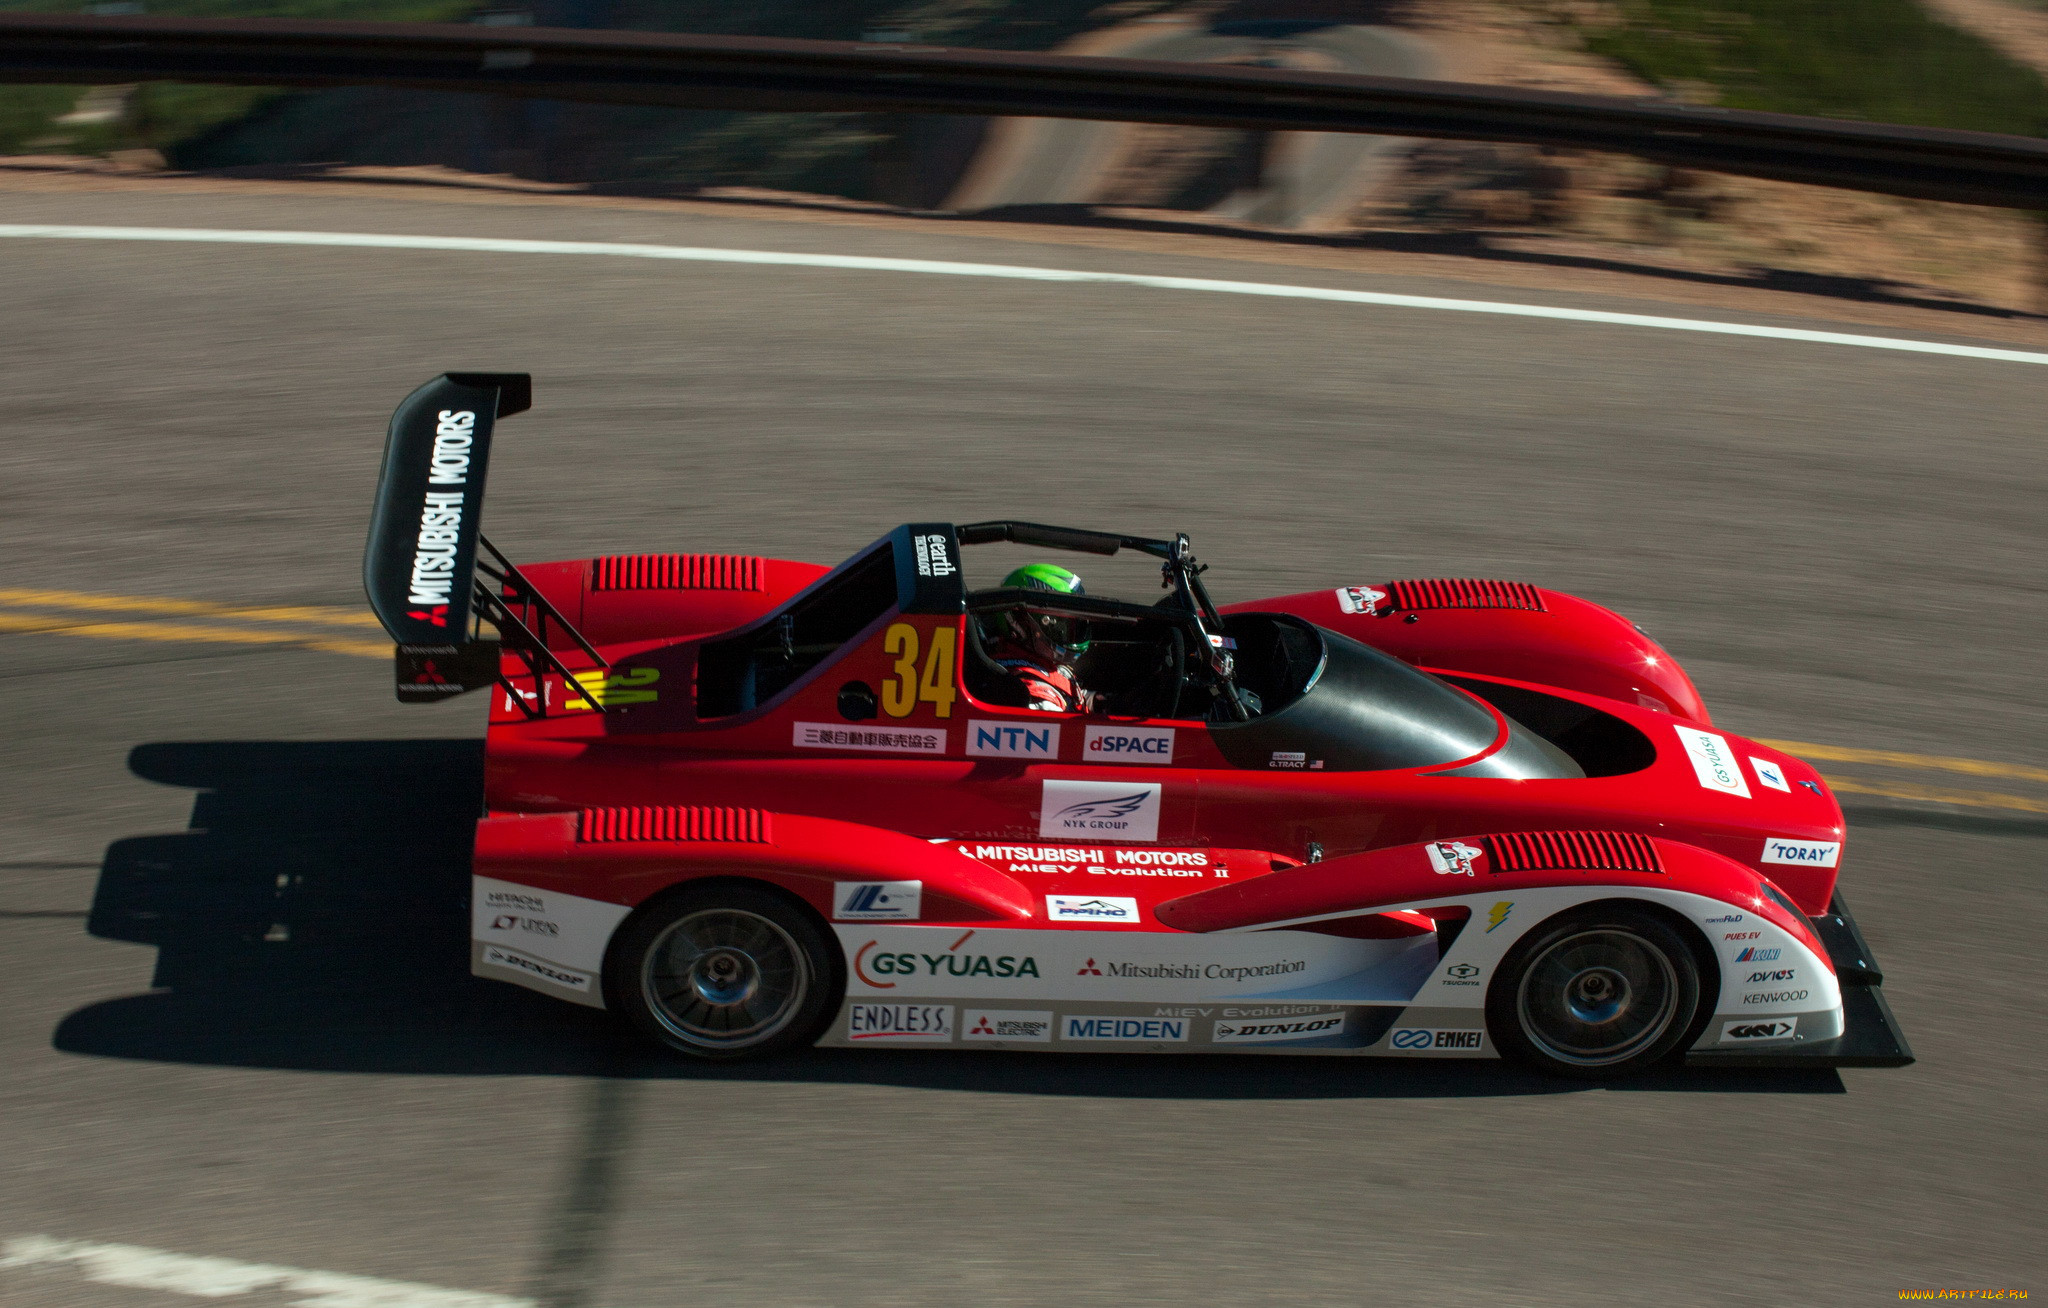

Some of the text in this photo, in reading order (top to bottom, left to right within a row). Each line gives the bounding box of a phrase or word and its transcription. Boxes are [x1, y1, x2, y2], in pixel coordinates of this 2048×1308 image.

[429, 410, 475, 484] MOTORS
[408, 492, 464, 604] MITSUBISHI
[882, 623, 956, 718] 34
[804, 729, 938, 749] 三菱自動車販売協会
[977, 726, 1049, 753] NTN
[1090, 736, 1169, 754] dSPACE
[1269, 760, 1305, 768] G.TRACY
[1699, 736, 1730, 783] GS YUASA
[1063, 820, 1129, 830] NYK GROUP
[976, 845, 1208, 866] MITSUBISHI MOTORS
[1009, 863, 1230, 878] MiEV Evolution II
[1725, 931, 1761, 940] PUES EV
[872, 953, 1040, 978] GS YUASA
[1107, 959, 1305, 982] Mitsubishi Corporation
[1743, 990, 1808, 1004] KENWOOD
[851, 1005, 945, 1031] ENDLESS
[1223, 1004, 1320, 1017] Evolution
[996, 1028, 1040, 1037] ELECTRIC
[997, 1020, 1047, 1030] MITSUBISHI
[1069, 1019, 1182, 1039] MEIDEN
[1236, 1018, 1342, 1036] DUNLOP
[1435, 1031, 1482, 1048] ENKEI
